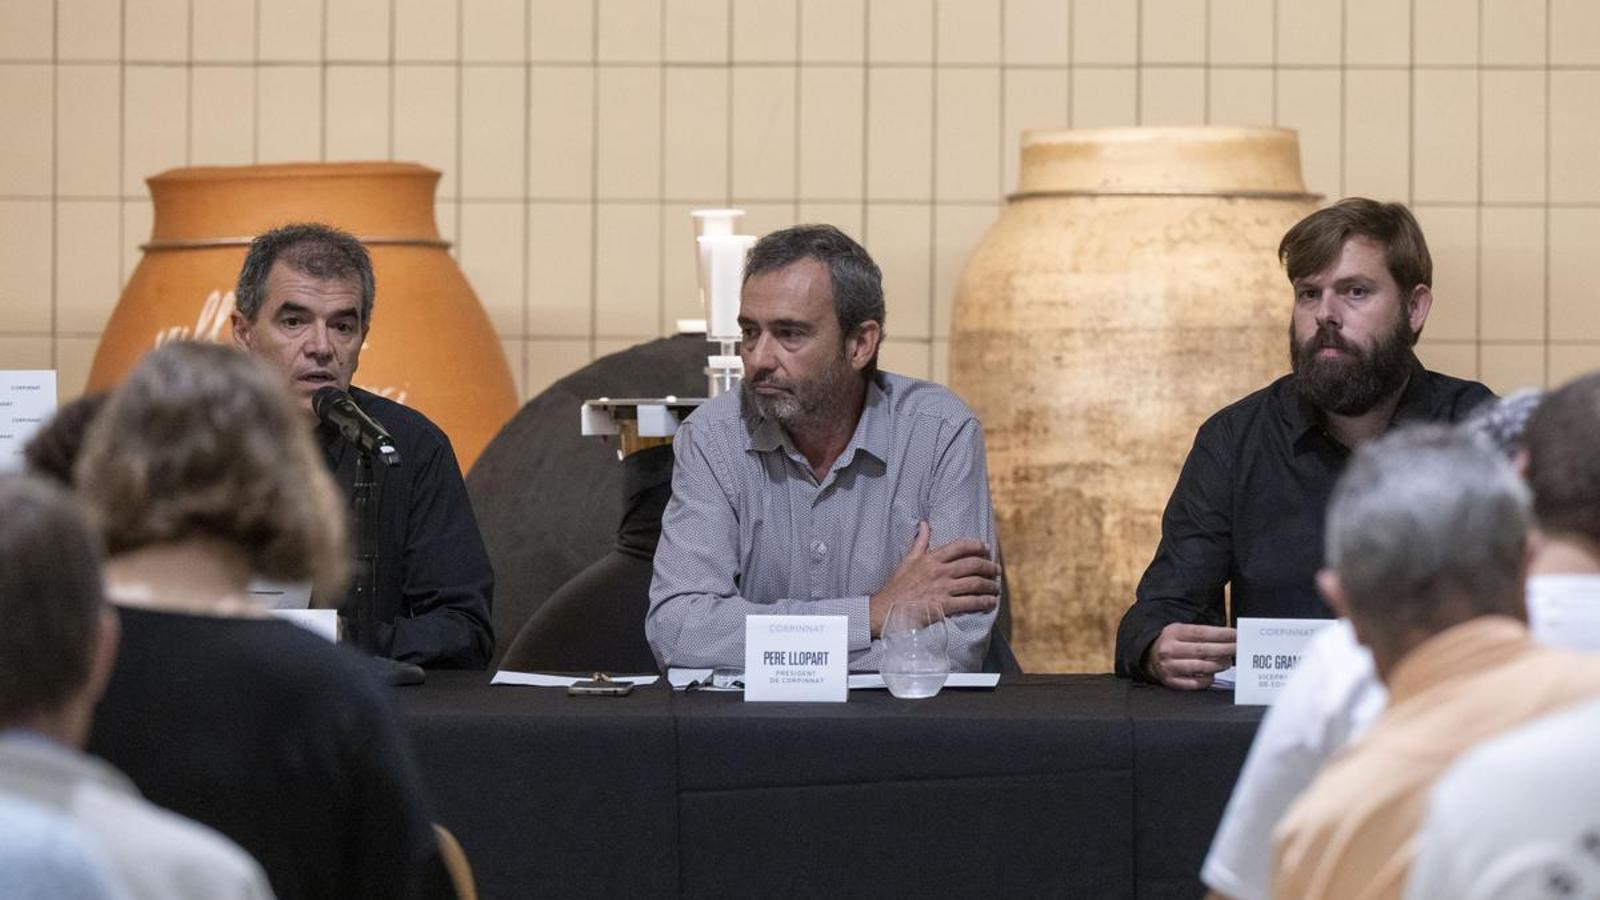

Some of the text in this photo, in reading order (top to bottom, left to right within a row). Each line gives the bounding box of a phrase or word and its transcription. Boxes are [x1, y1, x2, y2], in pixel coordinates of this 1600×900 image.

[769, 624, 825, 632] CORPINNAT
[763, 651, 829, 666] PERE LLOPART
[1252, 654, 1272, 669] ROC
